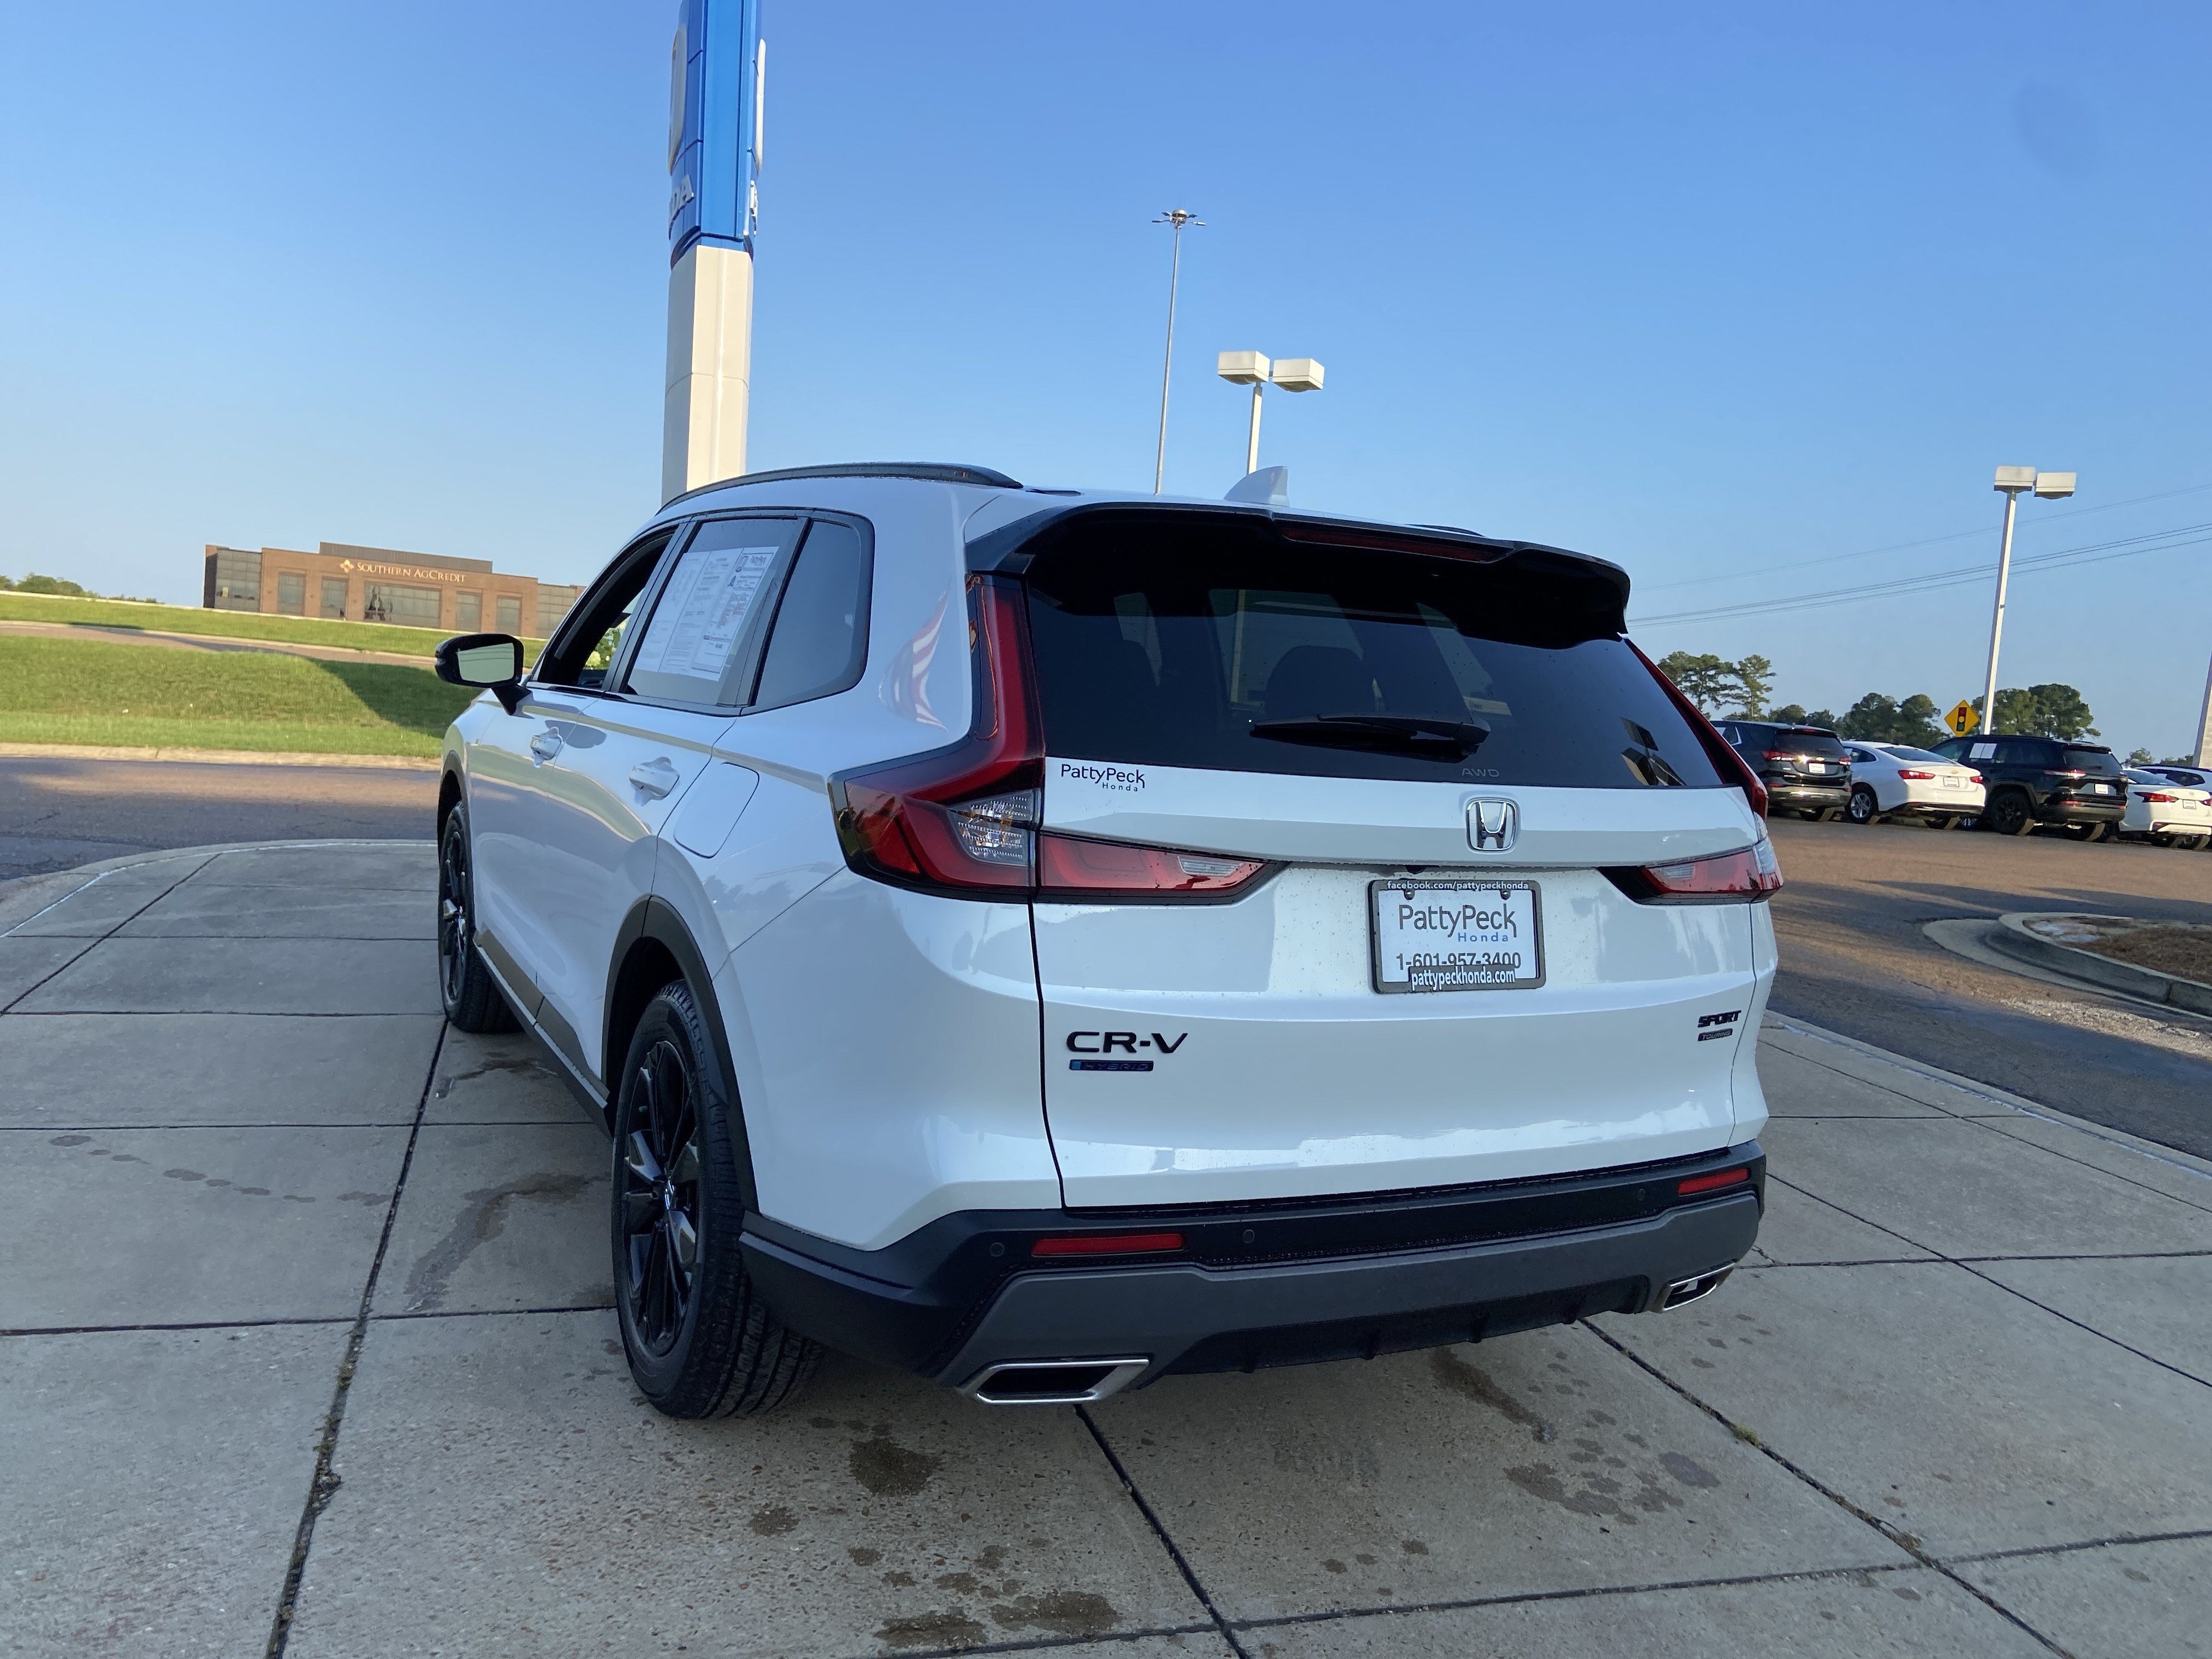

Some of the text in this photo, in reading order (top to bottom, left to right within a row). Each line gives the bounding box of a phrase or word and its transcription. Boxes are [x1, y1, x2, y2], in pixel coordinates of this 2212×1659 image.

[357, 562, 411, 576] SOUTHERN
[1061, 764, 1145, 788] PattyPeck
[1462, 768, 1499, 777] AWD
[1102, 782, 1138, 792] Honda
[1387, 881, 1528, 891] facebook.com/pattypeckhonda
[1399, 903, 1516, 938] PattyPeck
[1458, 932, 1509, 942] Honda
[1396, 952, 1521, 970] 1-601-957-3400
[1411, 965, 1515, 991] pattypeckhonda.com
[1698, 1010, 1741, 1028] SPORT
[1066, 1031, 1188, 1053] CR-V
[1703, 1030, 1731, 1040] TOURING
[1082, 1062, 1149, 1070] HYBRID
